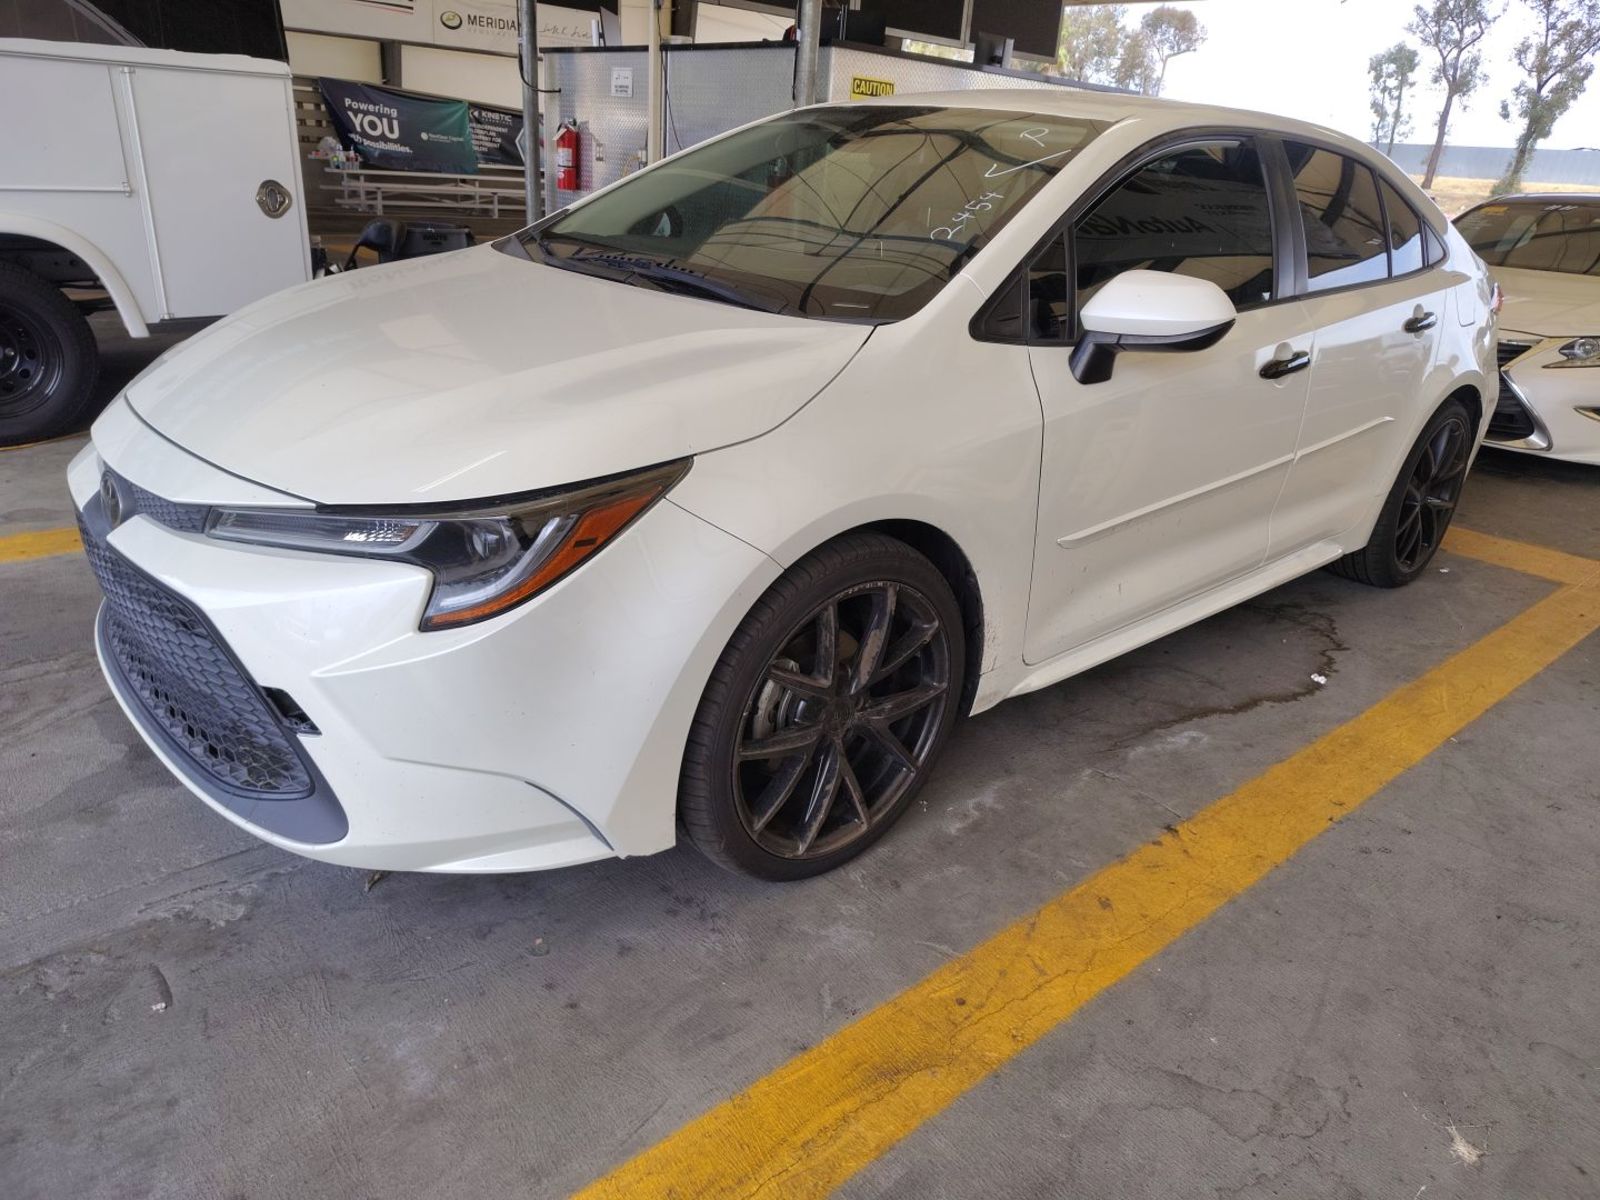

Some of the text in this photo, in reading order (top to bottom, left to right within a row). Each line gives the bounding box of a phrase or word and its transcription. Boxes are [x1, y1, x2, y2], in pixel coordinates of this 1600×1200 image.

[467, 13, 519, 31] MERIDIA
[853, 79, 893, 96] CAUTION
[344, 97, 398, 118] Powering
[347, 110, 400, 140] YOU
